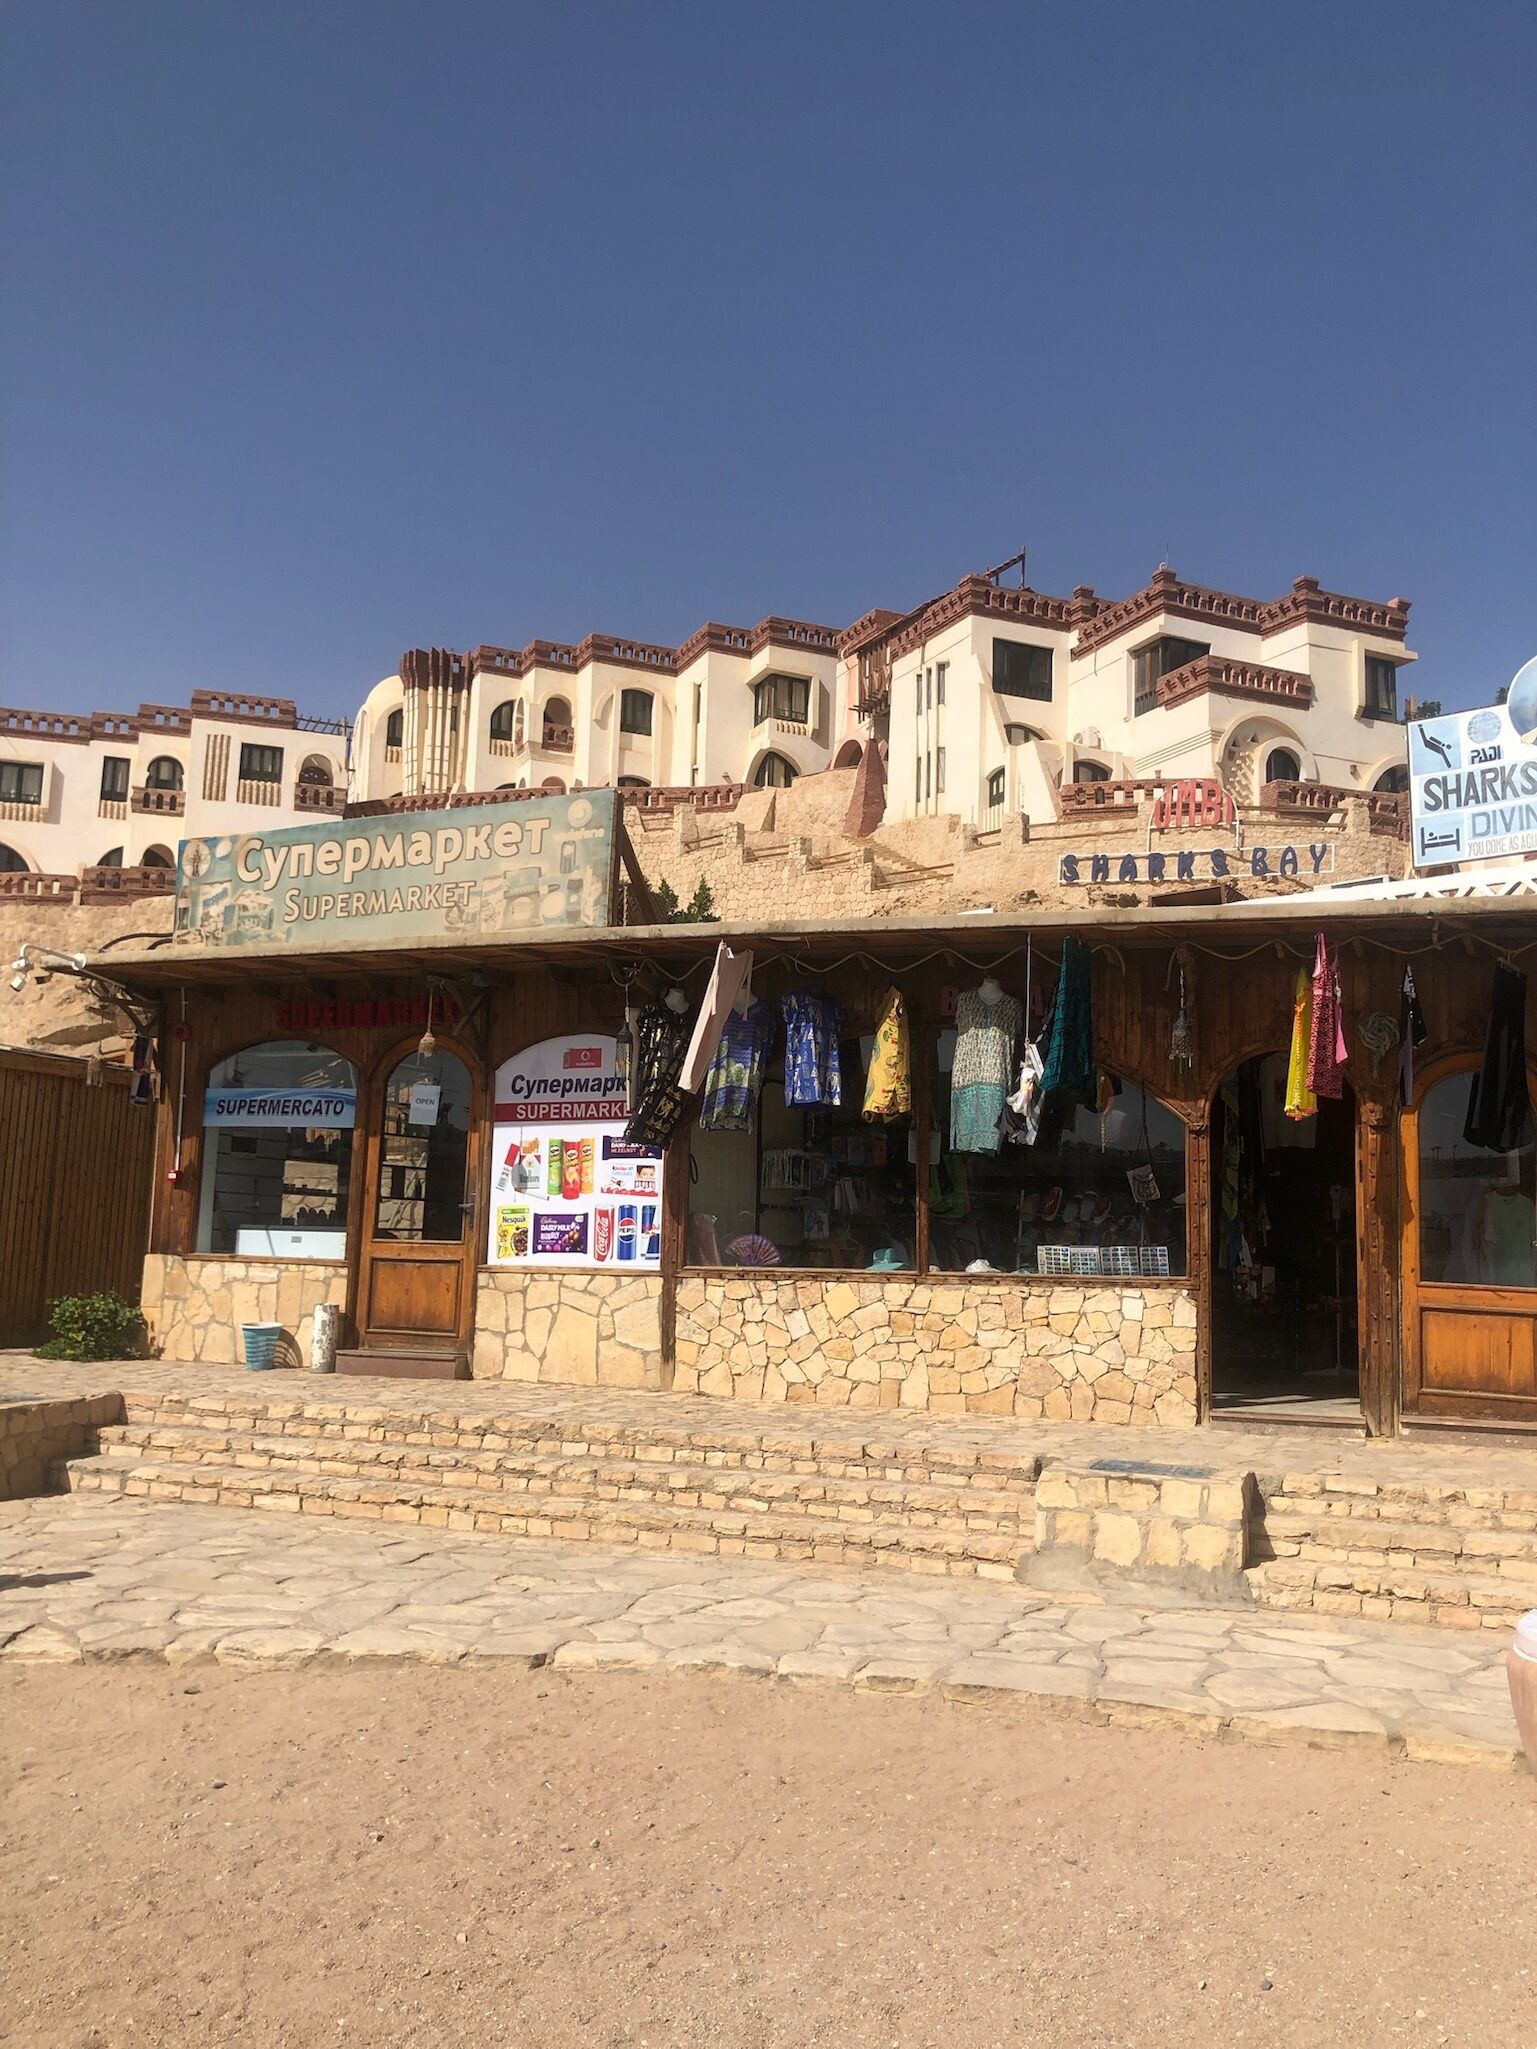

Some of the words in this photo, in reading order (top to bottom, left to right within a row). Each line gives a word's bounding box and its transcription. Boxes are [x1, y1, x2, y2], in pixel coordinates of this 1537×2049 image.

[1423, 760, 1537, 812] SHARKS
[236, 818, 551, 891] Супермаркет
[1061, 848, 1230, 882] SHARKS
[1251, 844, 1328, 877] BAY
[283, 880, 477, 922] SUPERMARKET
[215, 1098, 345, 1116] SUPERMERCATO
[415, 1096, 435, 1106] OPEN
[502, 1215, 527, 1224] Nesquik
